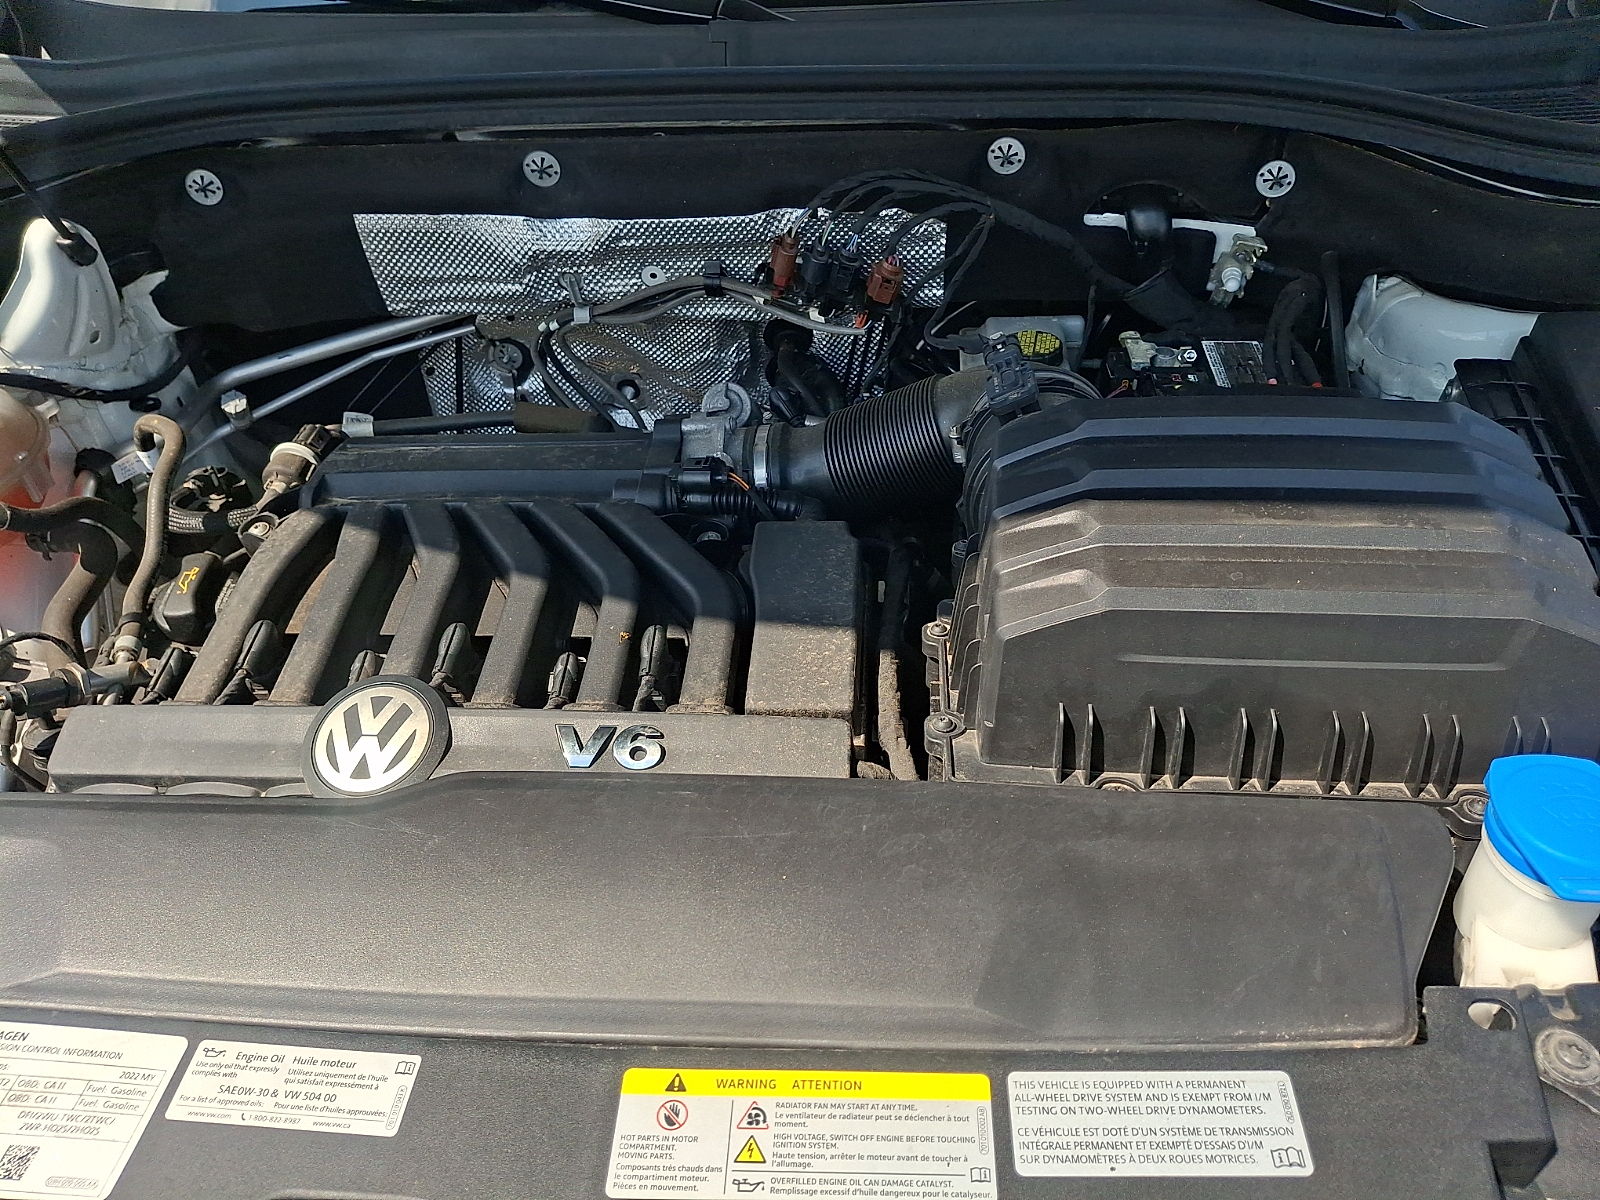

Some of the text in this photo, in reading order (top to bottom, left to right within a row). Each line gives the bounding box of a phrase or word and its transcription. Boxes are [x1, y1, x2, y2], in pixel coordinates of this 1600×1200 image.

[555, 724, 667, 770] V6
[21, 1044, 124, 1060] CONTROL INFORMATION
[235, 1051, 285, 1063] Engine Oil
[208, 1061, 224, 1070] only
[248, 1065, 280, 1074] expressly
[292, 1056, 357, 1068] Huile moteur
[119, 1071, 157, 1081] 2022 MY
[191, 1069, 221, 1077] complies
[287, 1068, 356, 1080] Utilisez uniquement
[296, 1077, 324, 1086] satisfait
[324, 1080, 373, 1090] expressément
[716, 1078, 861, 1090] WARNING ATTENTION
[1012, 1079, 1246, 1090] THIS VEHICLE IS EQUIPPED WITH A PERMANENT
[87, 1084, 147, 1097] Fuel: Gasoline
[270, 1088, 279, 1098] &
[284, 1089, 302, 1099] VW
[301, 1091, 322, 1101] 504
[323, 1093, 337, 1102] 00
[196, 1095, 208, 1103] list
[216, 1098, 250, 1106] approved
[1014, 1092, 1271, 1102] ALL-WHEEL DRIVE SYSTEM AND IS EXEMPT FROM I/M
[78, 1098, 140, 1111] Fuel: Gasoline
[273, 1101, 290, 1109] Pour
[304, 1104, 319, 1112] liste
[345, 1108, 388, 1117] approuvées:
[775, 1101, 812, 1109] RADIATOR
[847, 1102, 869, 1110] START
[897, 1103, 917, 1111] TIME.
[1015, 1105, 1266, 1115] TESTING ON TWO-WHEEL DRIVE DYNAMOMETERS.
[187, 1111, 231, 1119] www.vw.com
[838, 1112, 873, 1120] radiateur
[874, 1114, 892, 1122] peut
[904, 1113, 945, 1121] déclencher
[1017, 1125, 1294, 1136] CE VÉHICULE EST DOTÉ D'UN SYSTÈME DE TRANSMISSION
[637, 1134, 660, 1142] PARTS
[773, 1133, 792, 1141] HIGH
[793, 1133, 828, 1141] VOLTAGE,
[829, 1133, 858, 1141] SWITCH
[876, 1134, 904, 1142] ENGINE
[905, 1135, 935, 1143] BEFORE
[936, 1135, 975, 1143] TOUCHING
[619, 1142, 676, 1151] COMPARTMENT.
[808, 1141, 838, 1150] SYSTEM.
[1018, 1138, 1264, 1150] INTÉGRALE PERMANENT ET EXEMPTÉ D'ESSAIS D'I/M
[617, 1151, 674, 1160] MOVING PARTS.
[771, 1151, 795, 1159] Haute
[797, 1151, 827, 1160] tension,
[829, 1152, 856, 1160] arrêter
[857, 1152, 864, 1160] le
[920, 1154, 930, 1162] de
[931, 1154, 961, 1162] toucher
[963, 1154, 968, 1162] à
[1019, 1152, 1258, 1164] SUR DYNAMOMÈTRES À DEUX ROUES MOTRICES.
[615, 1162, 660, 1172] Composants
[677, 1164, 703, 1172] chauds
[704, 1164, 722, 1172] dans
[771, 1159, 813, 1169] l'allumage.
[614, 1172, 621, 1180] le
[621, 1173, 677, 1183] compartiment
[770, 1176, 816, 1185] OVERFILLED
[849, 1178, 861, 1186] OIL
[863, 1178, 879, 1186] CAN
[881, 1179, 914, 1187] DAMAGE
[915, 1179, 953, 1188] CATALYST.
[769, 1186, 992, 1199] Remplissage excessif d'huile dangereux pour le catalyseur.
